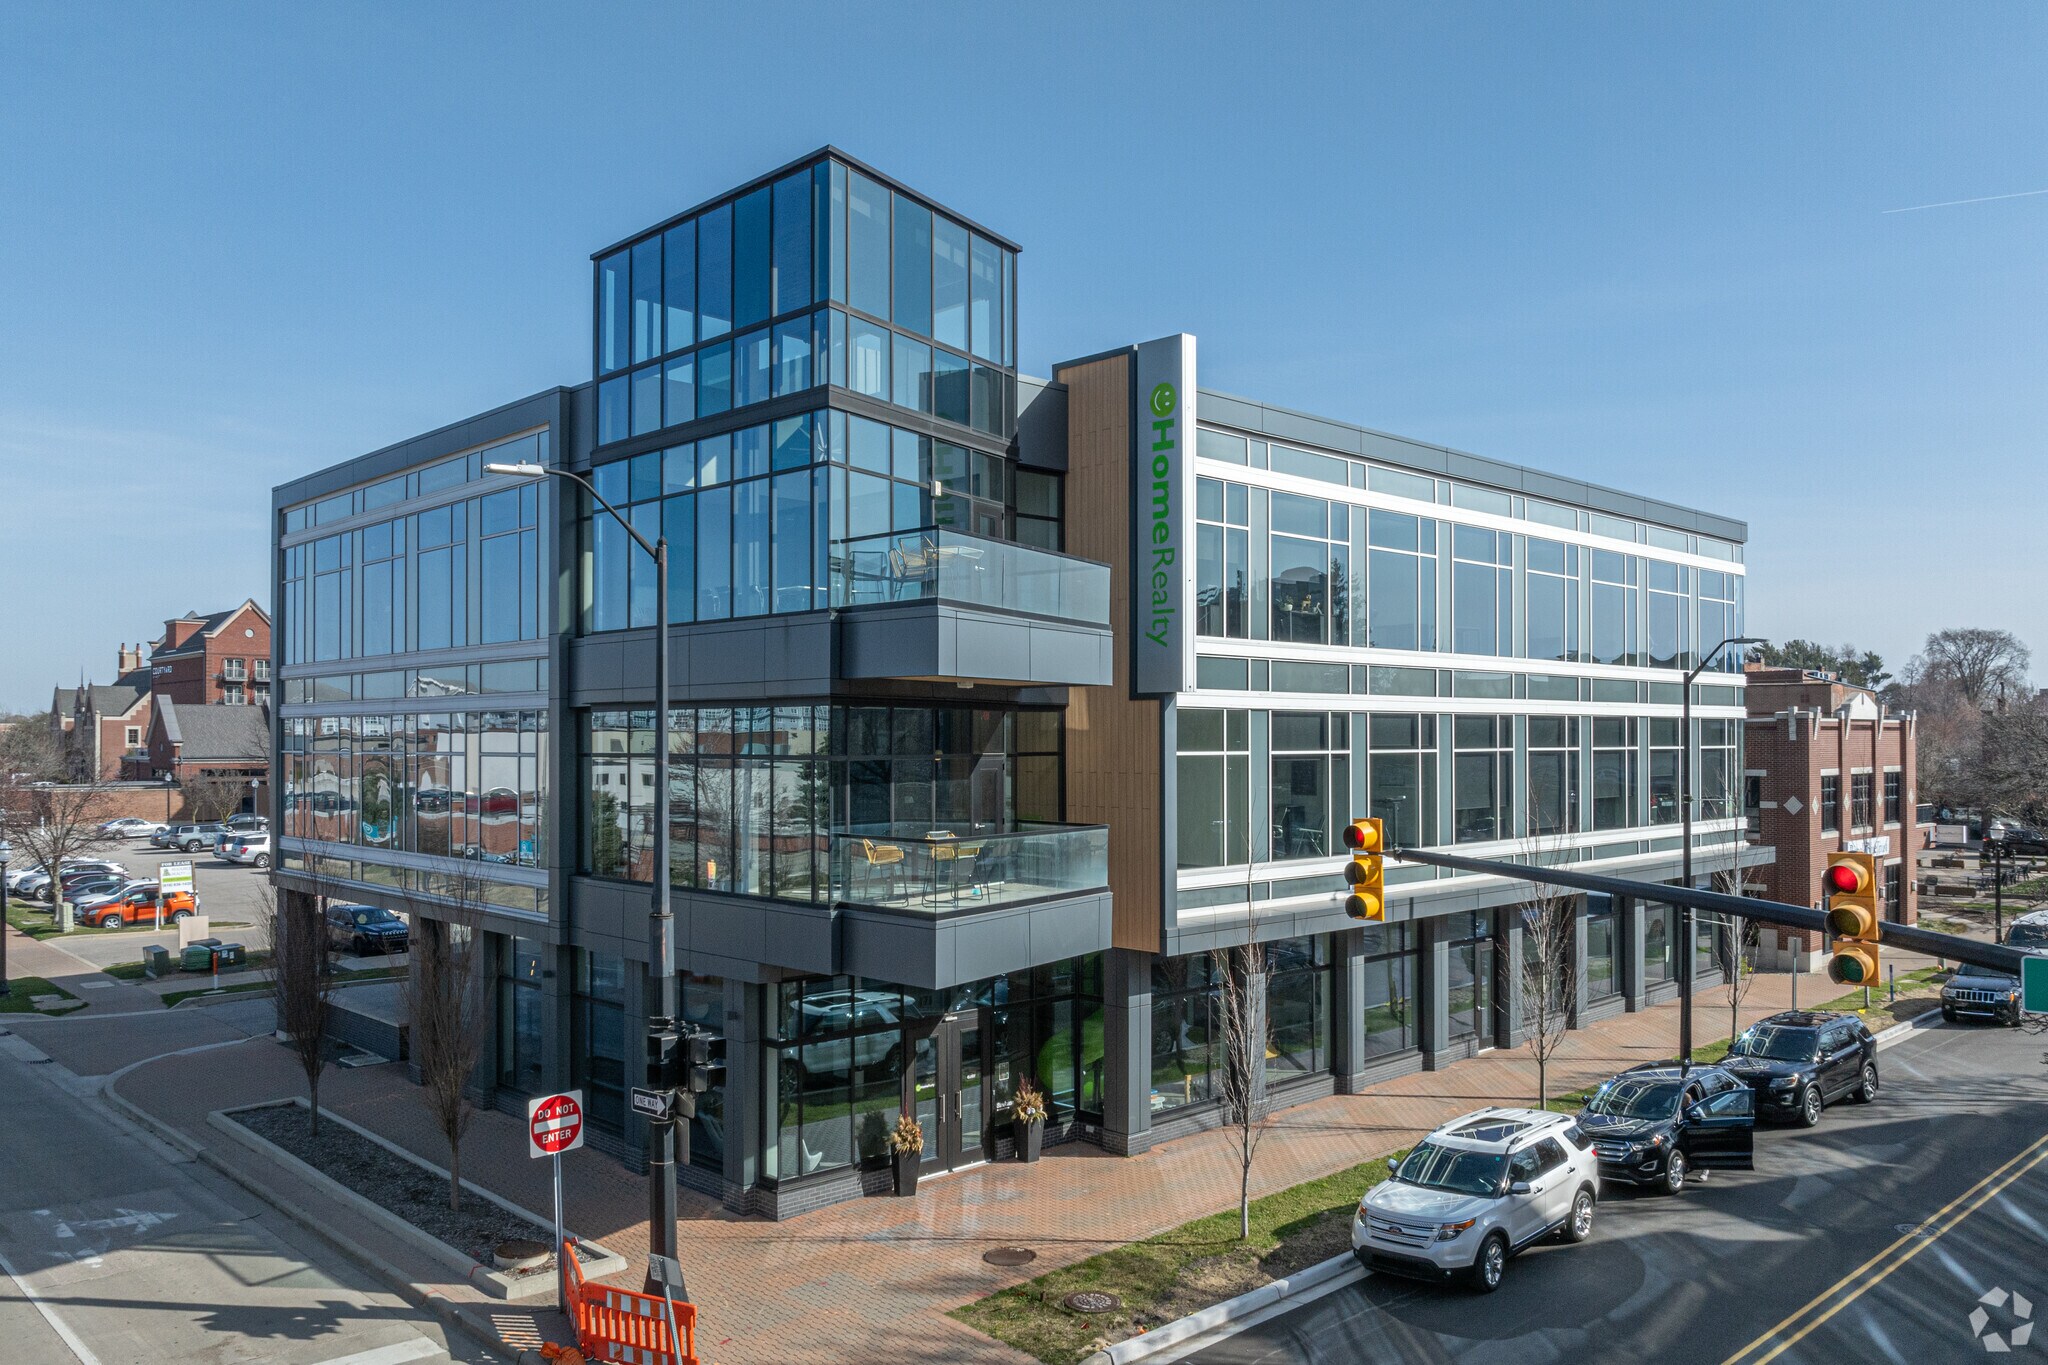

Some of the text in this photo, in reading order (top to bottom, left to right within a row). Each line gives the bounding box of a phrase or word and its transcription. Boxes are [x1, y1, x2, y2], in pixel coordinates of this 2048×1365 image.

[1145, 418, 1175, 648] HomeRealty
[636, 1095, 658, 1109] ONE WAY
[538, 1103, 574, 1120] DO NOT
[542, 1129, 571, 1144] ENTER
